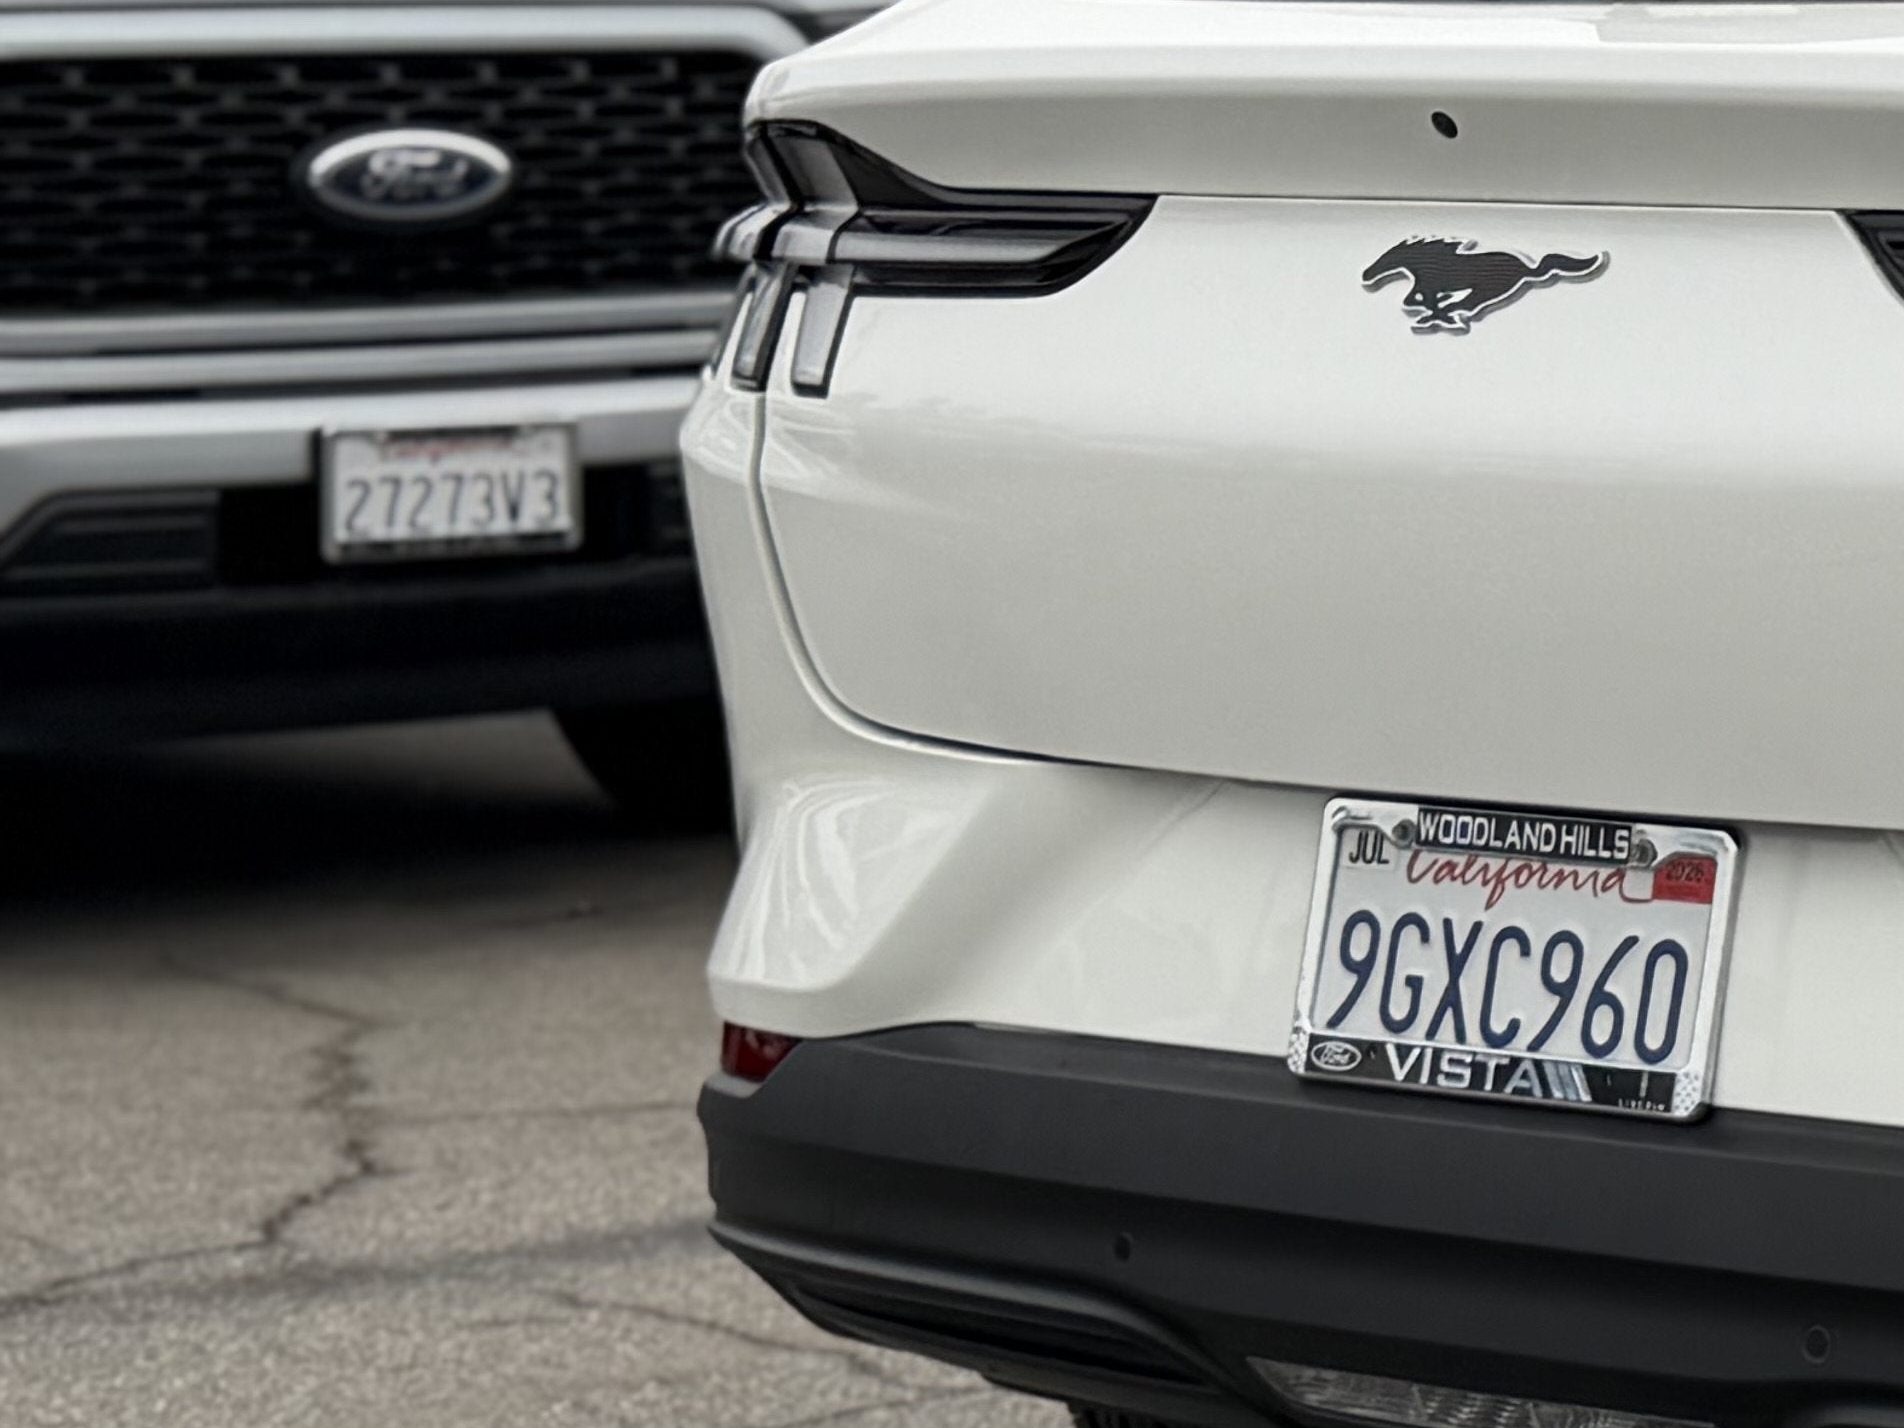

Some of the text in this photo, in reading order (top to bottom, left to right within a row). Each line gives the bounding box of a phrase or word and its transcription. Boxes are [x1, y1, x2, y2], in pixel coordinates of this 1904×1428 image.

[345, 469, 560, 533] 27273V3
[1349, 830, 1390, 865] JUL
[1418, 812, 1630, 861] WOODLAND HILLS
[1406, 848, 1654, 911] California
[1325, 909, 1689, 1065] 9GXC960
[1385, 1042, 1543, 1098] VISTA
